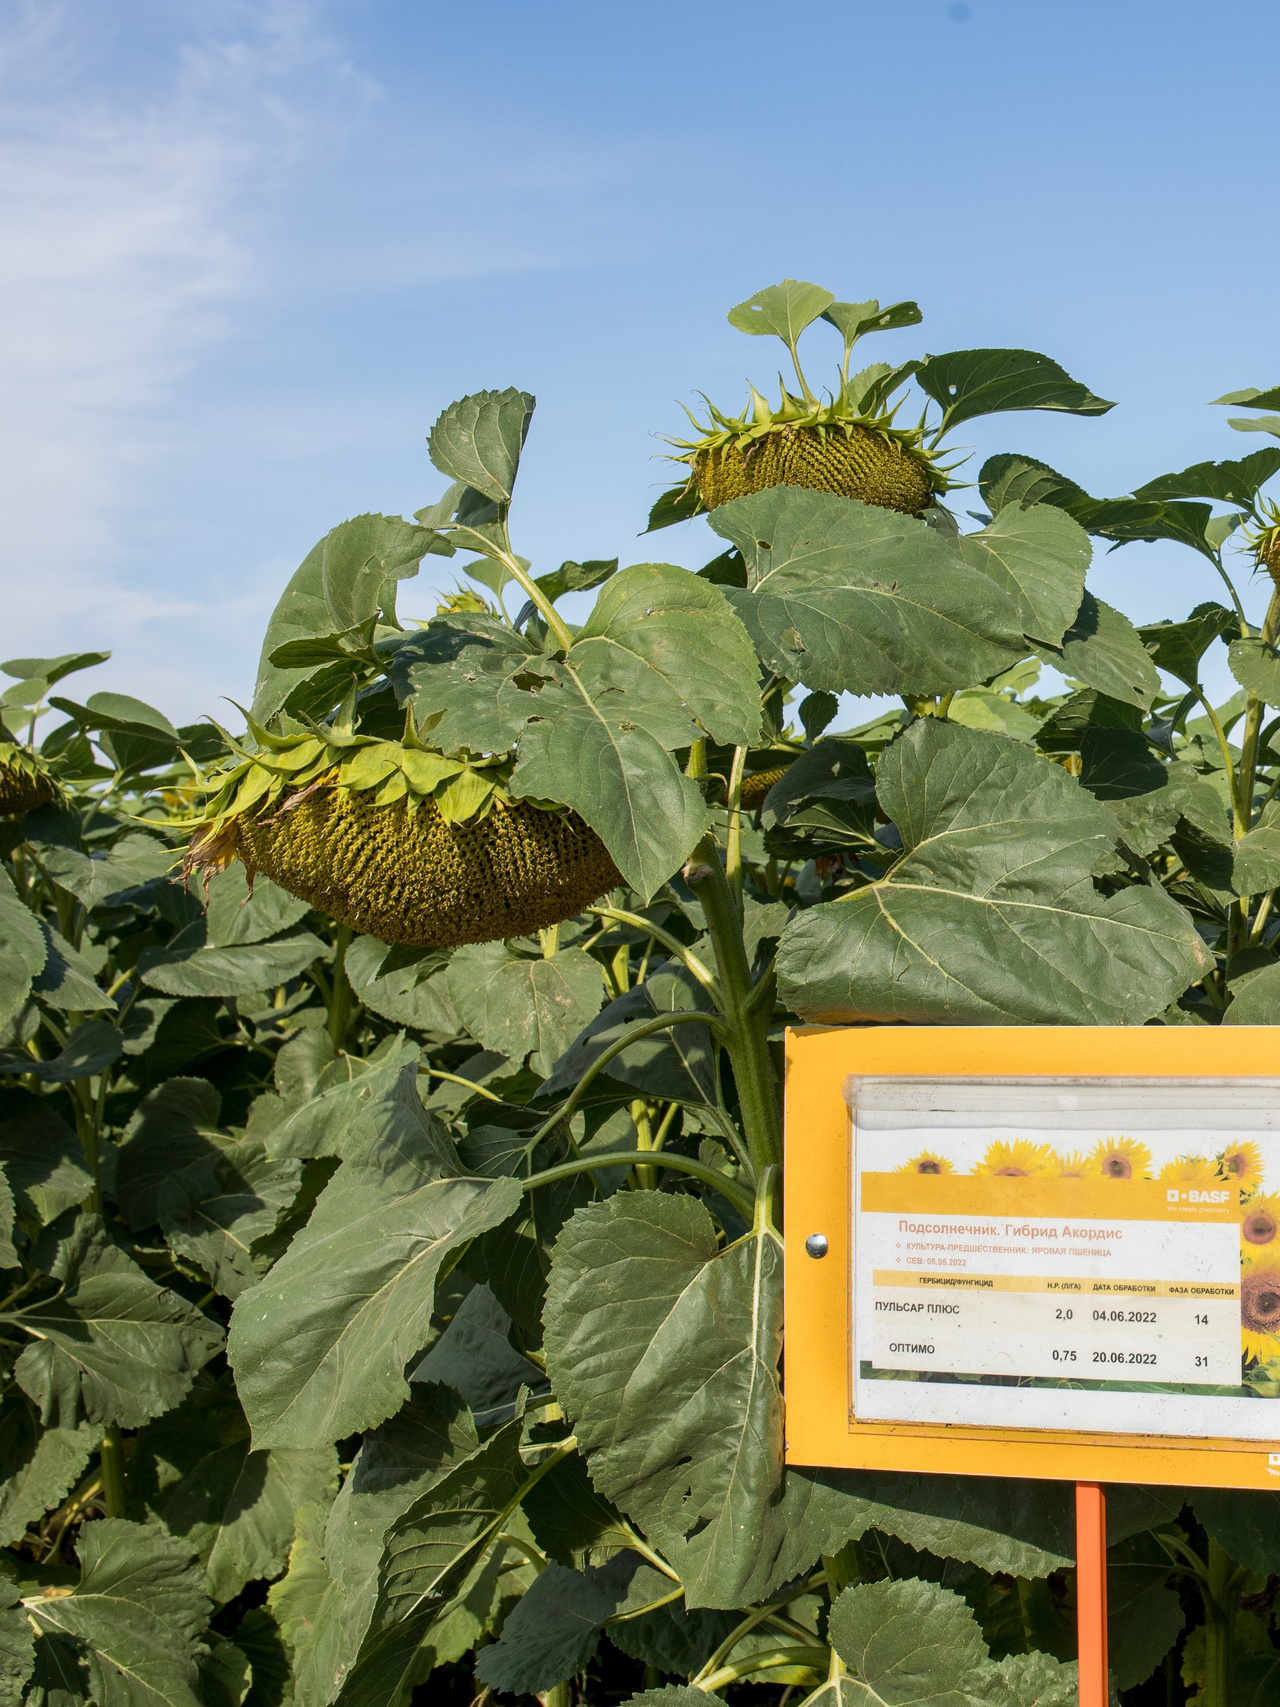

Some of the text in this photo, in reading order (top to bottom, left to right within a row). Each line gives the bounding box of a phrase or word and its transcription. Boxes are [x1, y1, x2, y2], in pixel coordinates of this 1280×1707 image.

[1188, 1190, 1230, 1204] BASF
[1199, 1207, 1230, 1215] chemistry
[898, 1220, 1123, 1241] Подсолнечник. Гибрид Акордис
[906, 1242, 1112, 1257] КУЛЬТУРА-ПРЕДШЕСТВЕННИК: ЯРОВАЯ ПШЕНИЦА
[906, 1256, 967, 1267] СЕВ: 05.05.2022
[919, 1277, 1235, 1296] ГЕРБИЦИД/ФУНГИЦИД Н.Р. (Л/ГА) ДАТА ОБРАБОТКИ ФАЗА ОБРАБОТКИ
[875, 1301, 1209, 1325] ПУЛЬСАР ПЛЮС 2,0 04.06.2022 14
[889, 1342, 1208, 1367] ОПТИМО 0,75 20.06.2022 31
